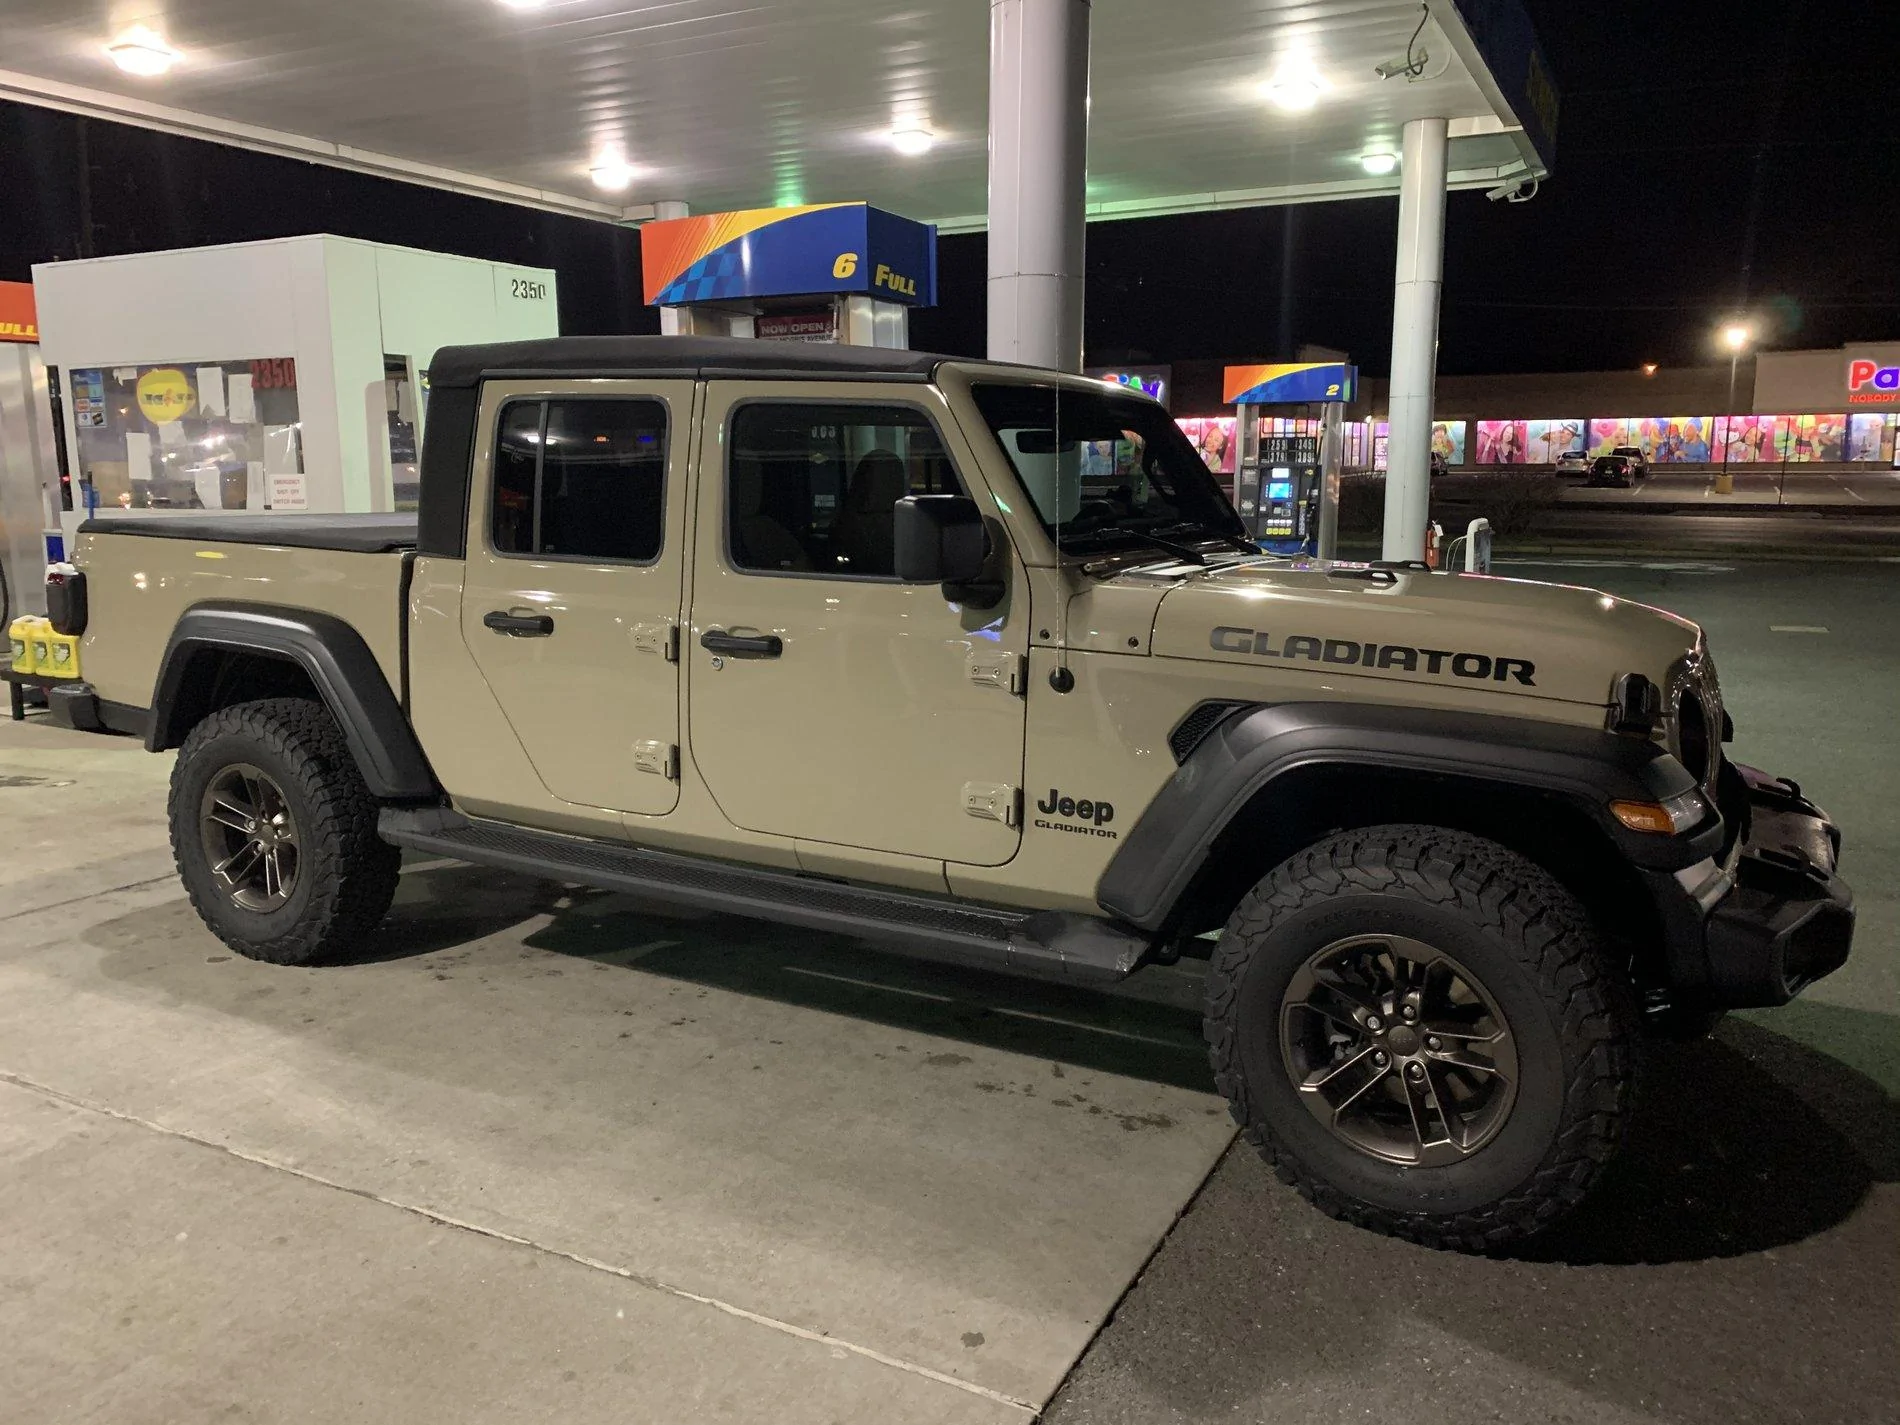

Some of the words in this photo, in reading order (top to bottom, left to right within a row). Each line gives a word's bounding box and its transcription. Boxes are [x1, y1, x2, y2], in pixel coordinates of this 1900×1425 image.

[832, 252, 859, 279] 6
[511, 278, 546, 300] 2350
[874, 263, 917, 296] FULL
[761, 324, 787, 335] NOW
[791, 322, 824, 333] OPEN
[1325, 384, 1340, 396] 2
[1849, 394, 1897, 403] NOBODY
[1210, 626, 1536, 687] GLADIATOR
[1037, 788, 1114, 826] Jeep
[1034, 819, 1118, 840] GLADIATOR
